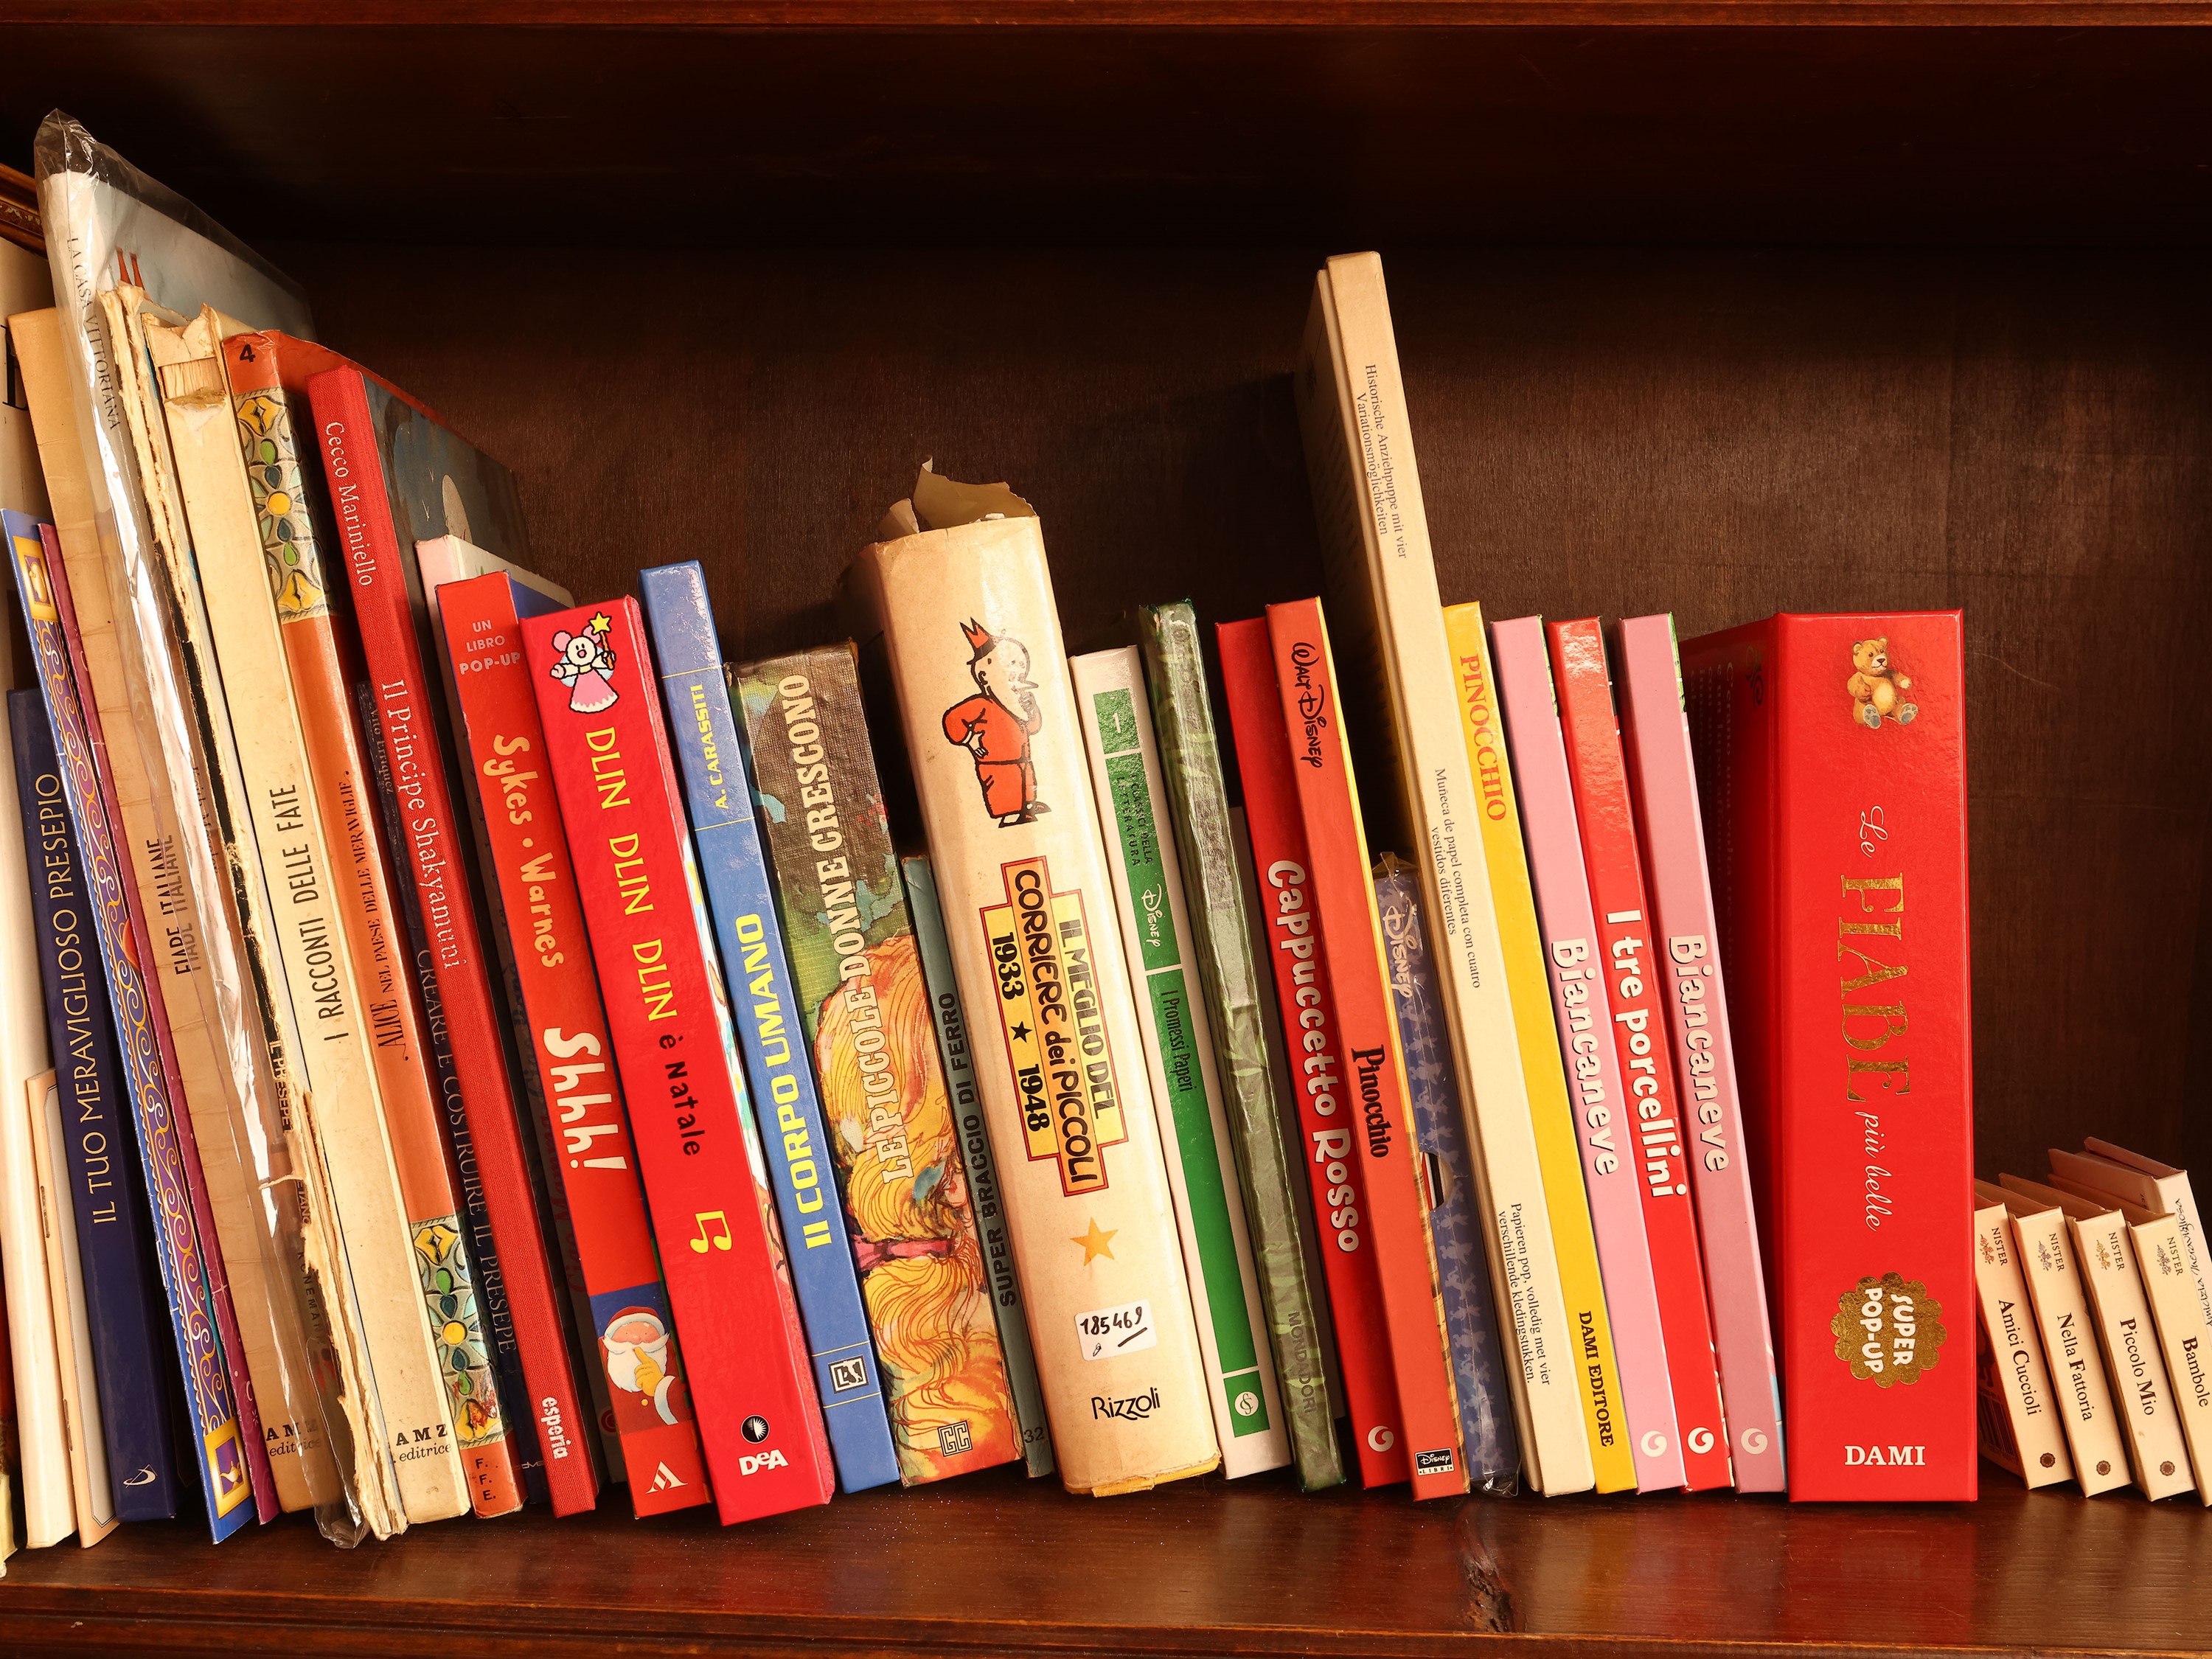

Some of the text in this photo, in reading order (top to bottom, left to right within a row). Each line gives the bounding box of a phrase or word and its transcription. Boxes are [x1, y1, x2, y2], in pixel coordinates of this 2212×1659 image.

[74, 264, 94, 309] CASA
[84, 314, 121, 431] VITTORIANA
[240, 344, 256, 364] 4
[324, 421, 373, 588] Cecco Mariniello
[1356, 392, 1388, 536] Variationsmöglichkeiten
[1365, 364, 1408, 560] Historische Anziehpuppe mit vier
[459, 652, 521, 675] POP-UP
[466, 635, 506, 653] LIBRO
[473, 619, 492, 633] UN
[689, 684, 730, 810] A. CARASSITI
[1112, 712, 1121, 734] 1
[1459, 653, 1507, 821] PINOCCHIO
[380, 679, 467, 969] Il Principe Shakyamuni
[482, 734, 539, 826] Sykes
[520, 852, 565, 969] Warnes
[1141, 832, 1154, 864] DELLA
[269, 784, 349, 1043] I RACCONTI DELLE FATE
[357, 868, 377, 914] DELLE
[779, 674, 914, 1183] LE PICCOLE DONNE CRESCONO
[1431, 827, 1457, 936] vestidos diferentes
[1435, 768, 1481, 989] Muñeca de papel completa con cuatro
[369, 919, 389, 962] PAESE
[379, 965, 395, 992] NEL
[585, 726, 706, 1158] DLIN DLIN DLIN è Natale
[735, 913, 792, 1071] UMANO
[35, 773, 117, 1225] IL TUO MERAVIGLIOSO PRESEPIO
[370, 999, 408, 1062] ALICE
[417, 949, 449, 1046] CREARE
[992, 931, 1051, 1133] 1933 1948
[1015, 869, 1099, 1183] CORRIERE dei PICCOLI
[1059, 919, 1118, 1120] IL MEGLIO DEL
[1163, 998, 1189, 1051] Promessi
[1837, 805, 1911, 1232] Le FIABE più belle
[543, 1028, 627, 1171] Shh!
[1169, 1052, 1197, 1092] Paperi
[1267, 859, 1360, 1253] Cappuccetto Rosso
[1351, 1044, 1391, 1159] Pinocchio
[1551, 938, 1620, 1176] Biancaneve
[1607, 909, 1687, 1197] I tre porcellini
[1669, 934, 1731, 1172] Biancaneve
[443, 1075, 488, 1217] COSTRUIRE
[771, 1074, 824, 1215] CORPO
[938, 992, 1017, 1308] SUPER BRACCIO DI FERRO
[473, 1220, 491, 1248] IL
[1991, 1227, 2008, 1267] NISTER
[2048, 1232, 2065, 1272] NISTER
[2108, 1231, 2125, 1271] NISTER
[2166, 1236, 2184, 1276] NISTER
[479, 1253, 517, 1354] PRESEPE
[1080, 1305, 1144, 1336] 185469
[1498, 1210, 1536, 1384] verschillende kledingstukken.
[1511, 1203, 1551, 1385] Papieren pop, volledig met vier
[1860, 1287, 1885, 1374] POP-UP
[1890, 1293, 1916, 1367] SUPER
[1091, 1387, 1161, 1421] Rizzoli
[1287, 1310, 1319, 1416] MONDADORI
[1579, 1310, 1614, 1447] DAMI EDITORE
[1998, 1299, 2042, 1416] Amici Cuccioli
[2057, 1312, 2095, 1422] Nella Fattoria
[2120, 1316, 2157, 1416] Piccolo Mio
[2182, 1335, 2211, 1408] Bambole
[399, 1443, 451, 1463] editrice
[476, 1458, 488, 1470] F.
[479, 1474, 492, 1485] F.
[540, 1397, 571, 1460] esperia
[1024, 1427, 1046, 1444] 32
[1844, 1445, 1926, 1466] DAMI
[483, 1489, 496, 1500] E.
